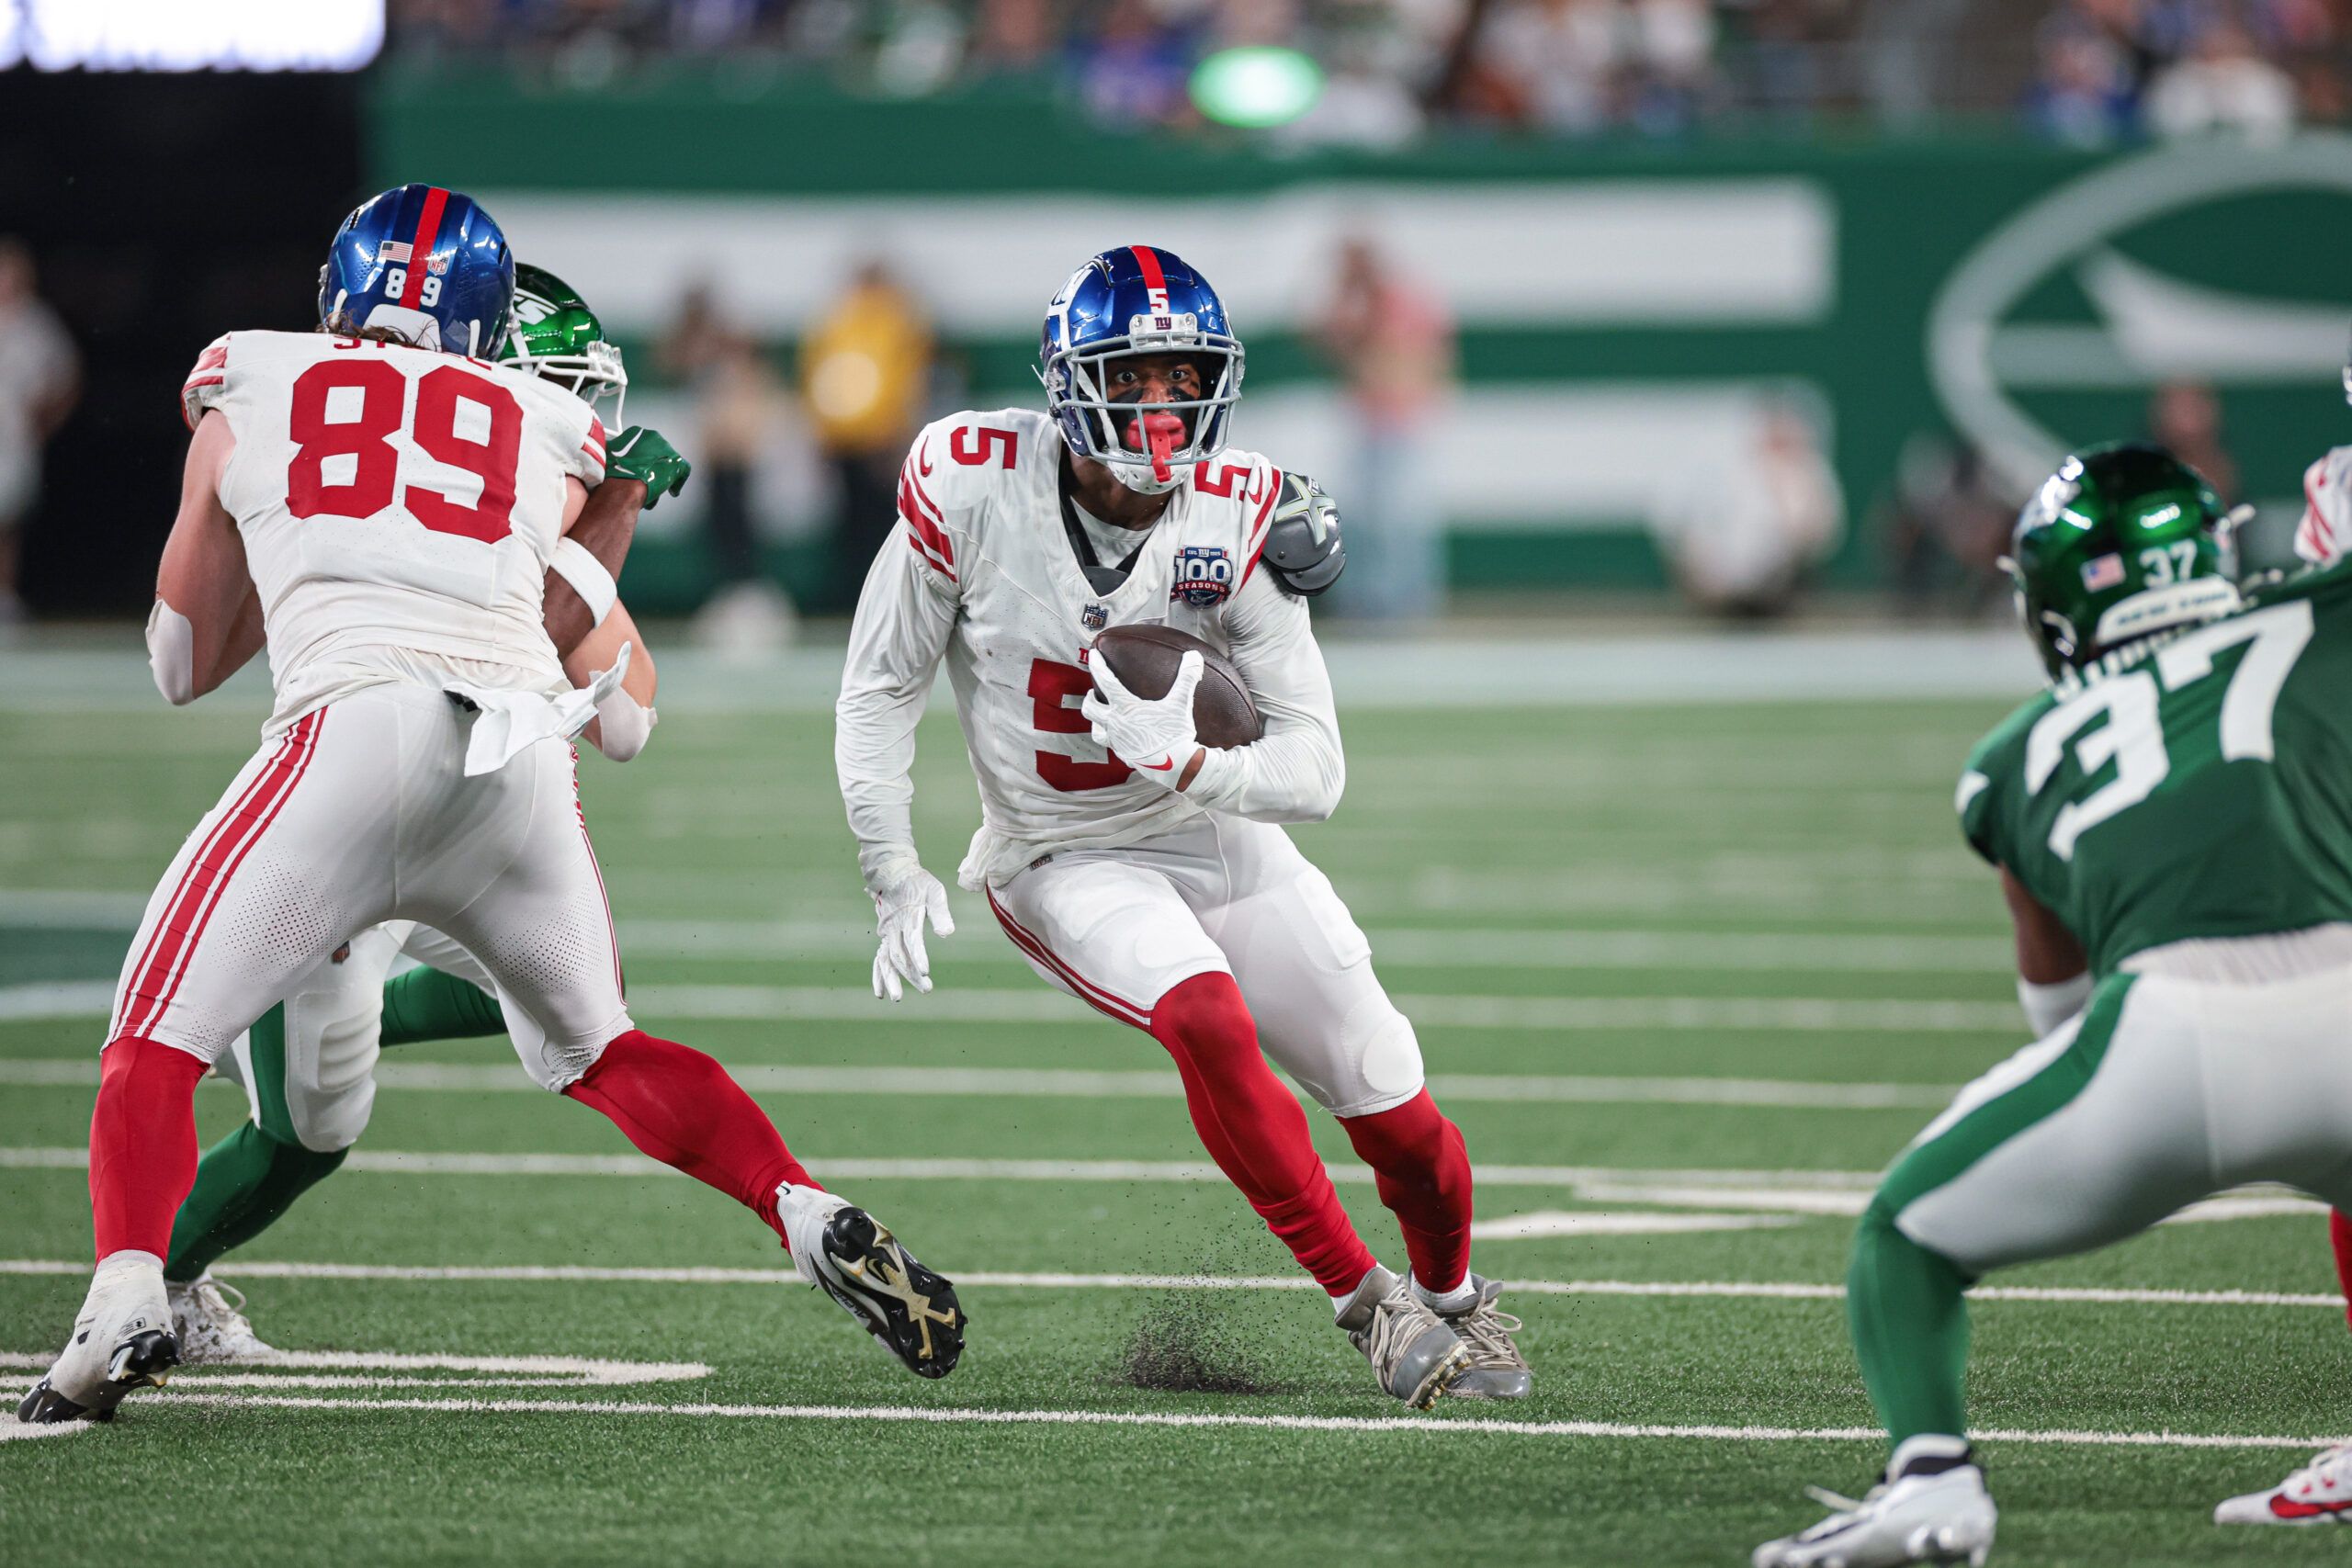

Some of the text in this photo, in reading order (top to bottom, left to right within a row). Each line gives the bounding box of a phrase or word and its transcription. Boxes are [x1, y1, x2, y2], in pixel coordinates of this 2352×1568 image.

[430, 260, 447, 273] NFL
[384, 267, 443, 308] 89
[1148, 288, 1170, 314] 5
[285, 359, 524, 545] 89
[951, 426, 1018, 469] 5
[1194, 460, 1251, 501] 5
[1175, 558, 1231, 583] 100
[2139, 538, 2199, 589] 37
[1179, 582, 1225, 592] SEASONS
[1027, 657, 1136, 792] 5
[2024, 598, 2315, 862] 37
